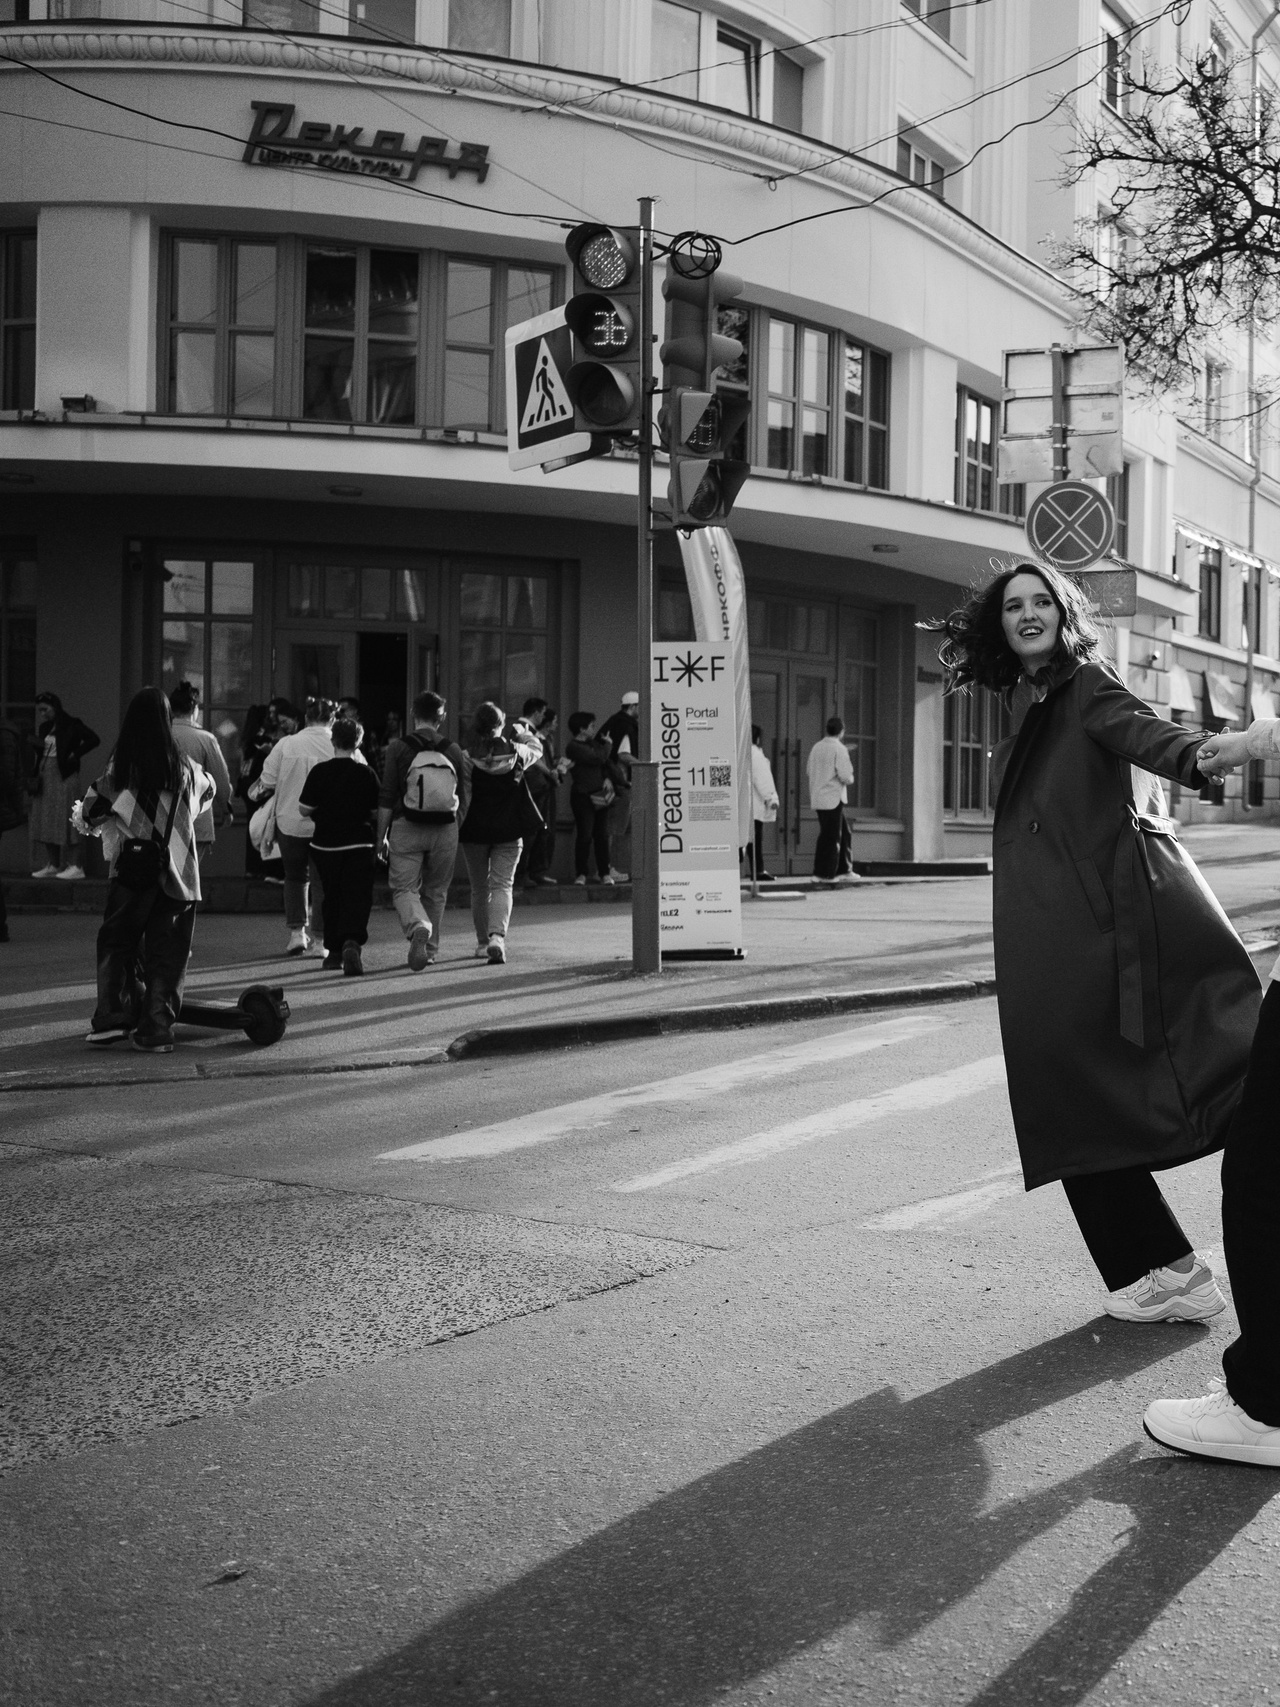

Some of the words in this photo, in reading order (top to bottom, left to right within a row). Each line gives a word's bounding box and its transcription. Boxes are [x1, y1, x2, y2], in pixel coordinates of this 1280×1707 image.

[685, 706, 719, 718] Portal
[660, 702, 683, 853] Dreamlaser
[687, 766, 706, 786] 11
